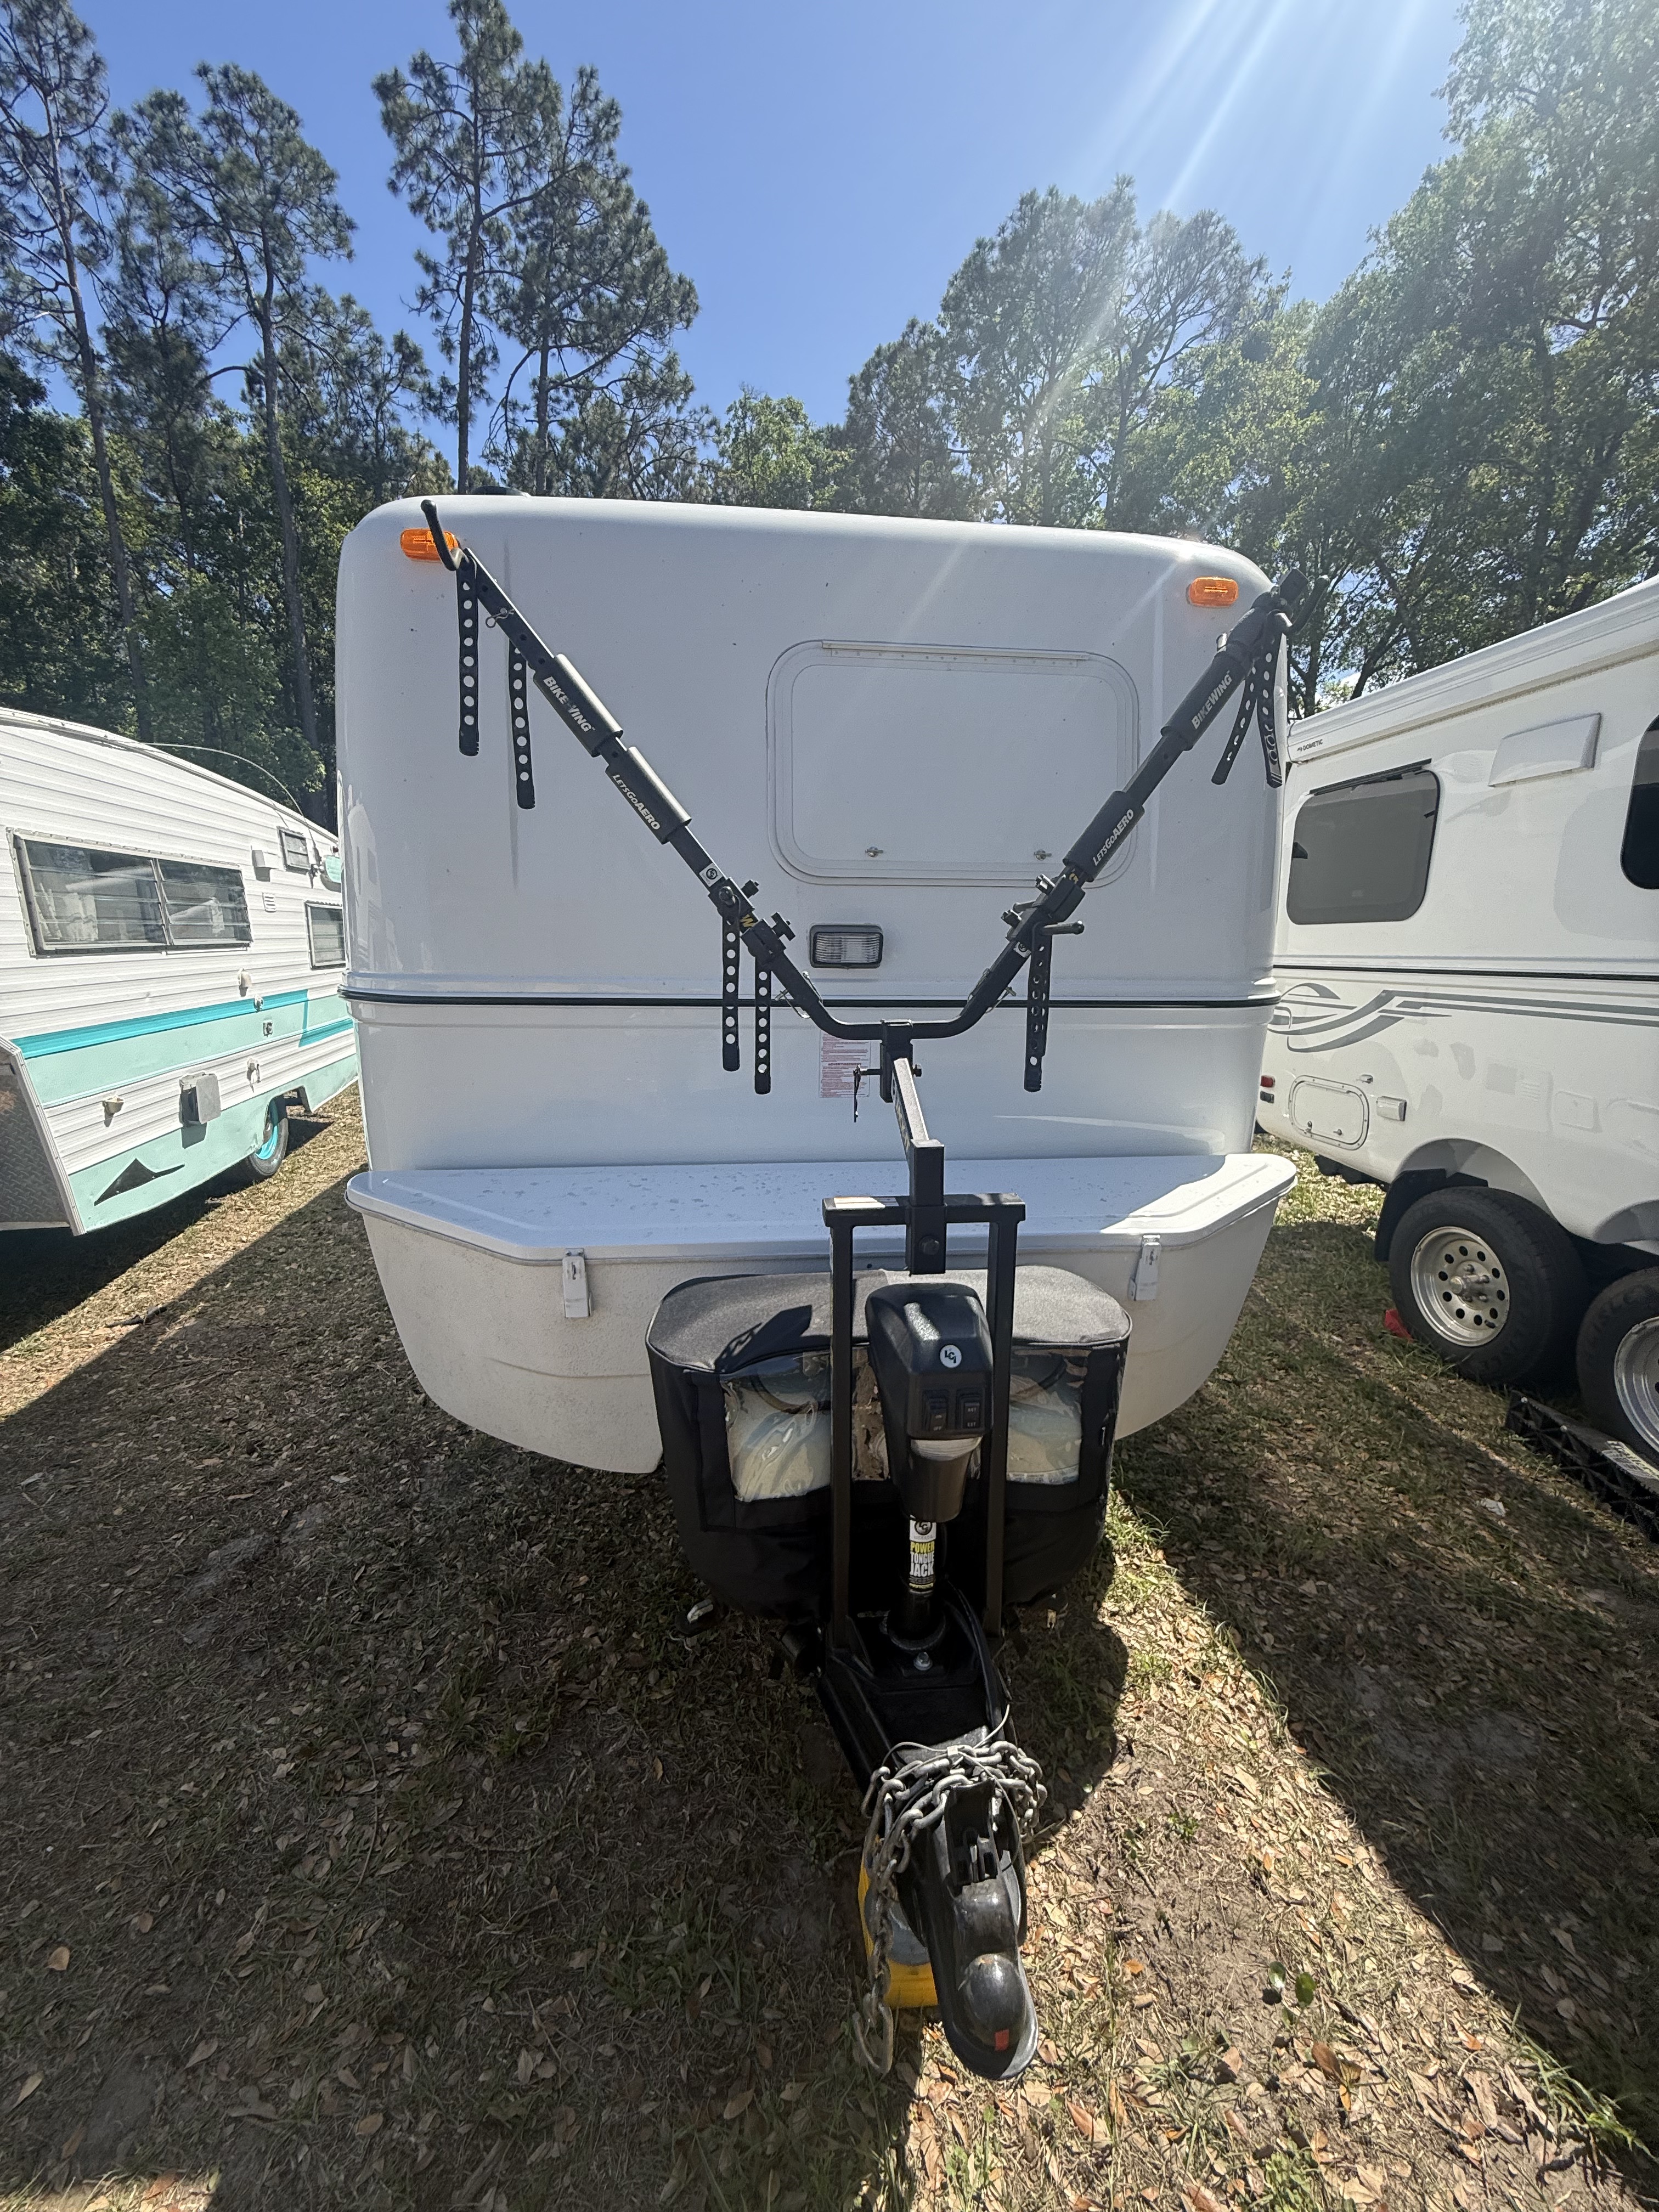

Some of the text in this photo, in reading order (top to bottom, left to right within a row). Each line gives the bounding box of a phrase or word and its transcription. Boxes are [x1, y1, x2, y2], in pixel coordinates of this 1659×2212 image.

[910, 1541, 935, 1553] POWER
[910, 1551, 934, 1564] TONGUE
[909, 1561, 934, 1577] JACK
